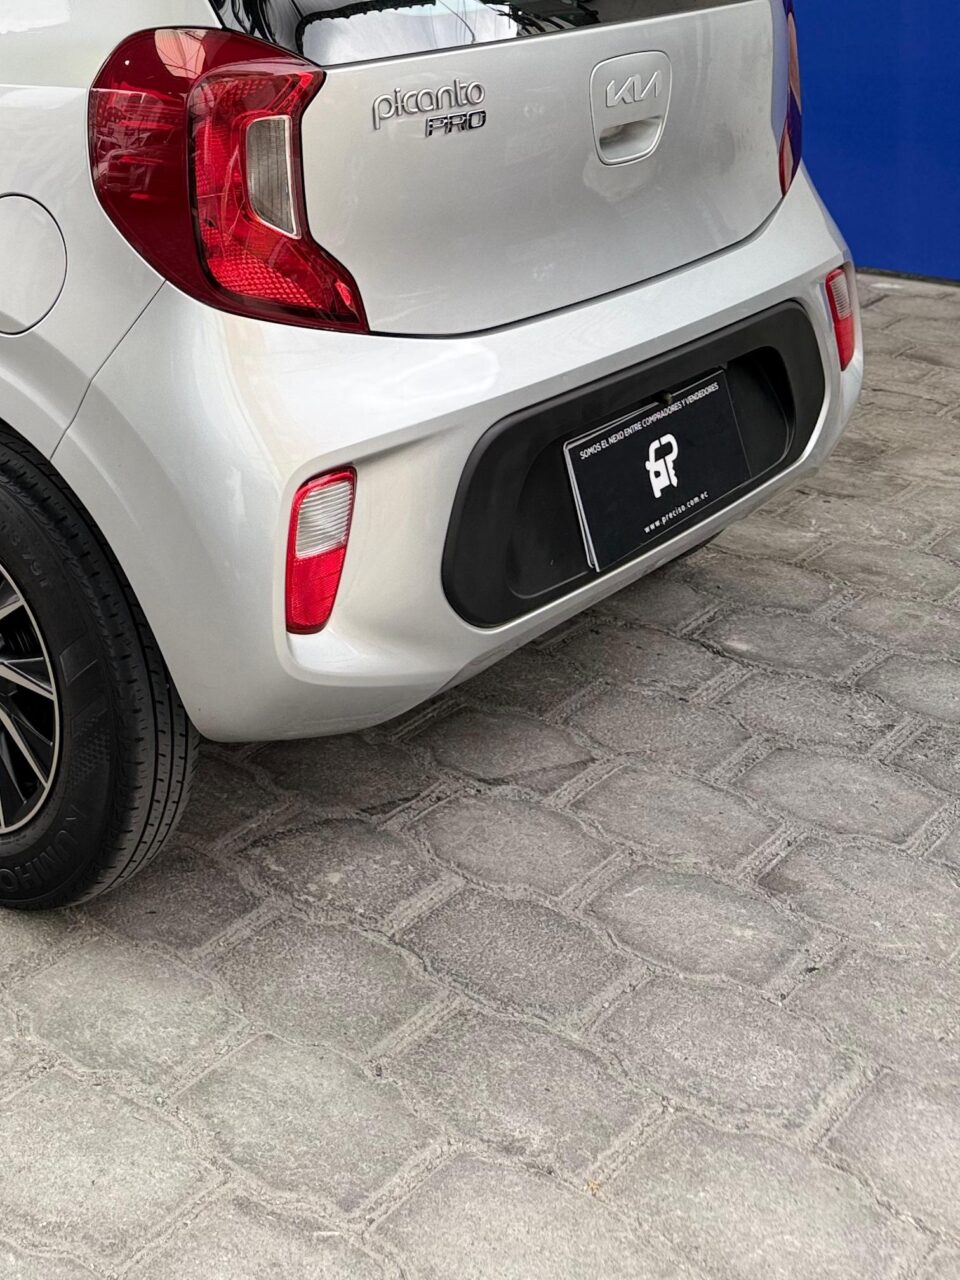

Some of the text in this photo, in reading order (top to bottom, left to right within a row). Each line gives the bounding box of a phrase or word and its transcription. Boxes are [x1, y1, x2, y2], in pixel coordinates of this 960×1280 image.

[372, 78, 486, 131] picanto
[425, 110, 487, 137] PRO
[579, 442, 601, 460] SOMOS
[601, 439, 610, 449] EL
[608, 430, 625, 446] NEXO
[624, 421, 643, 437] ENTRE
[642, 401, 682, 428] COMPRADORES
[685, 382, 720, 406] VENDEDORES
[643, 490, 709, 534] www.preciso.com.ec
